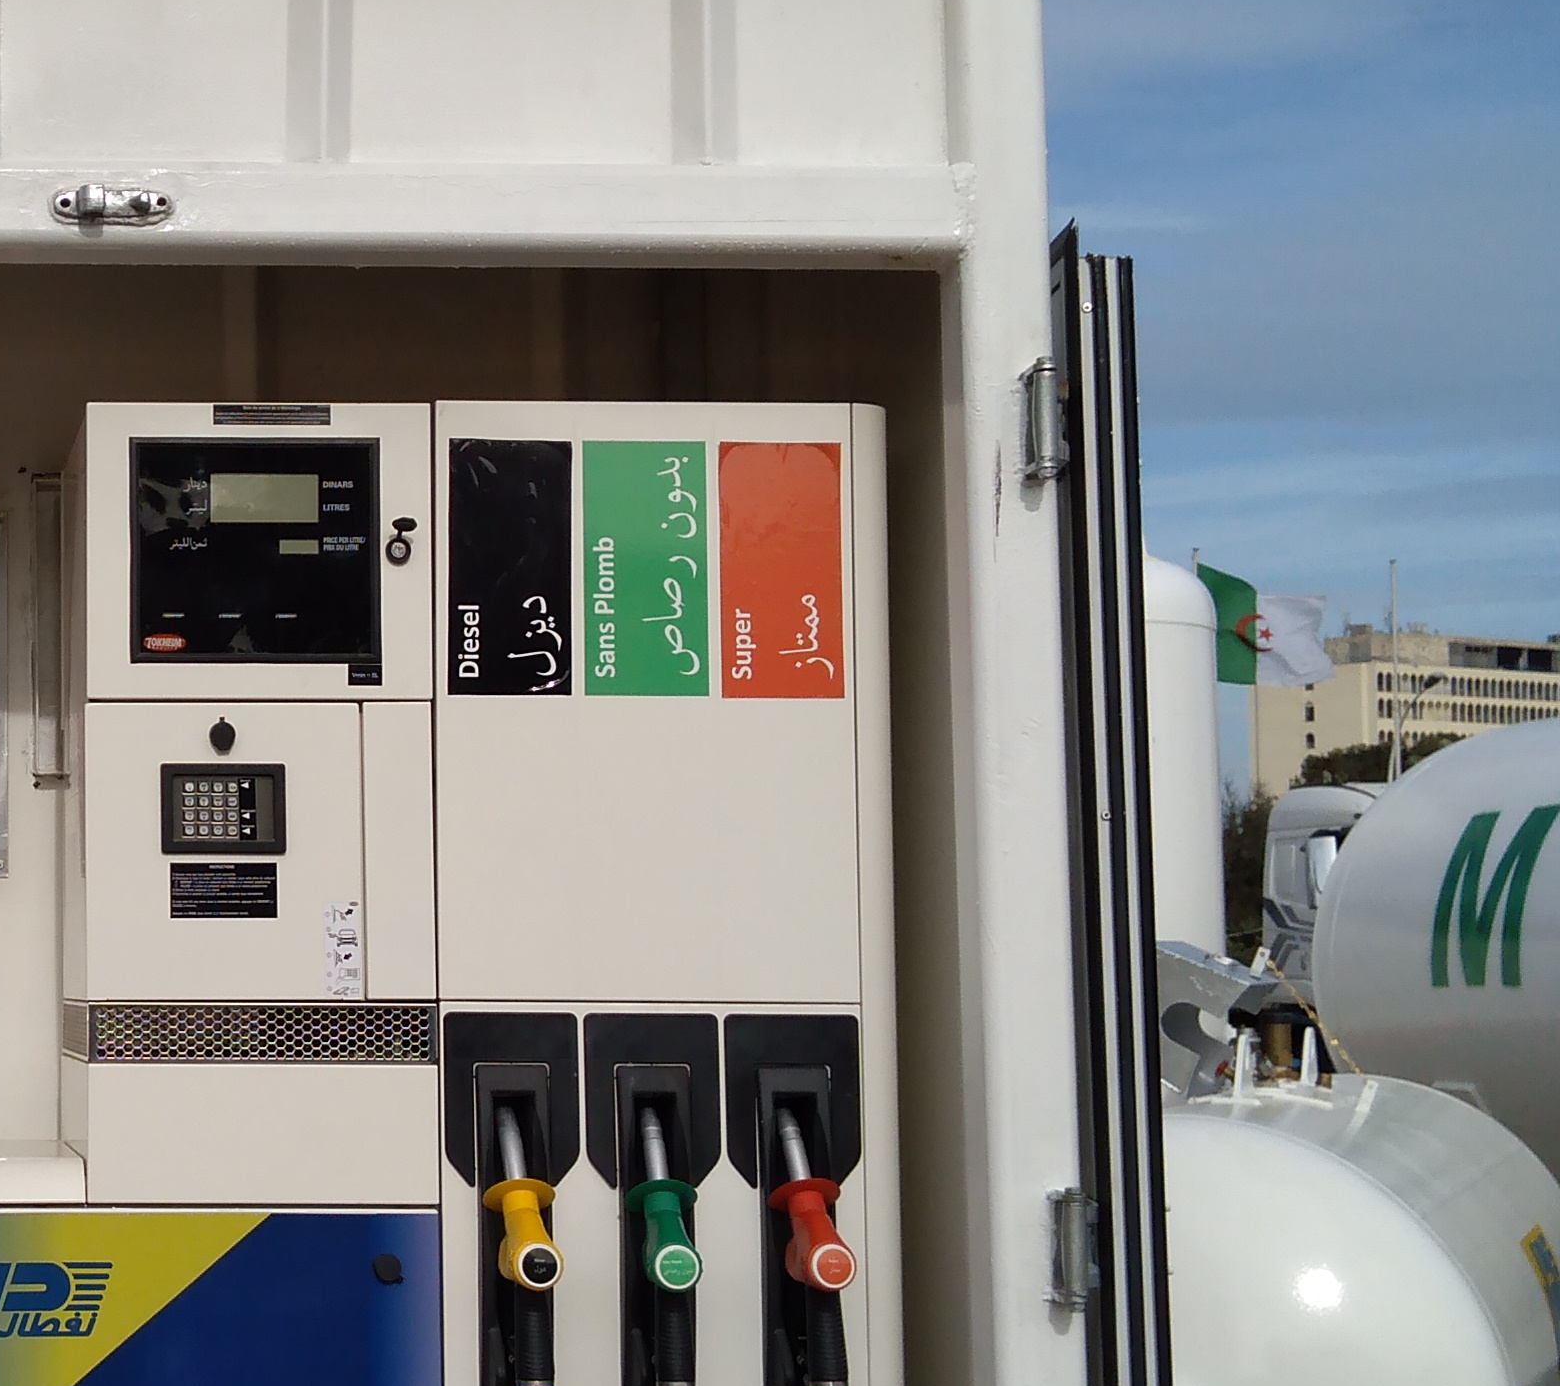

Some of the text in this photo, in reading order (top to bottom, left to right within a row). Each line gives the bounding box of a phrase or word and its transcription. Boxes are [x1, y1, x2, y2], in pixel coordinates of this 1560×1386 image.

[322, 480, 354, 488] DINARS
[322, 503, 350, 511] LITRES
[642, 455, 701, 676] بدون رصاص
[457, 603, 480, 679] Diesel
[506, 594, 563, 677] ديزل
[592, 536, 616, 679] Sans Plomb
[731, 608, 757, 681] Super
[778, 592, 836, 680] ممتاز
